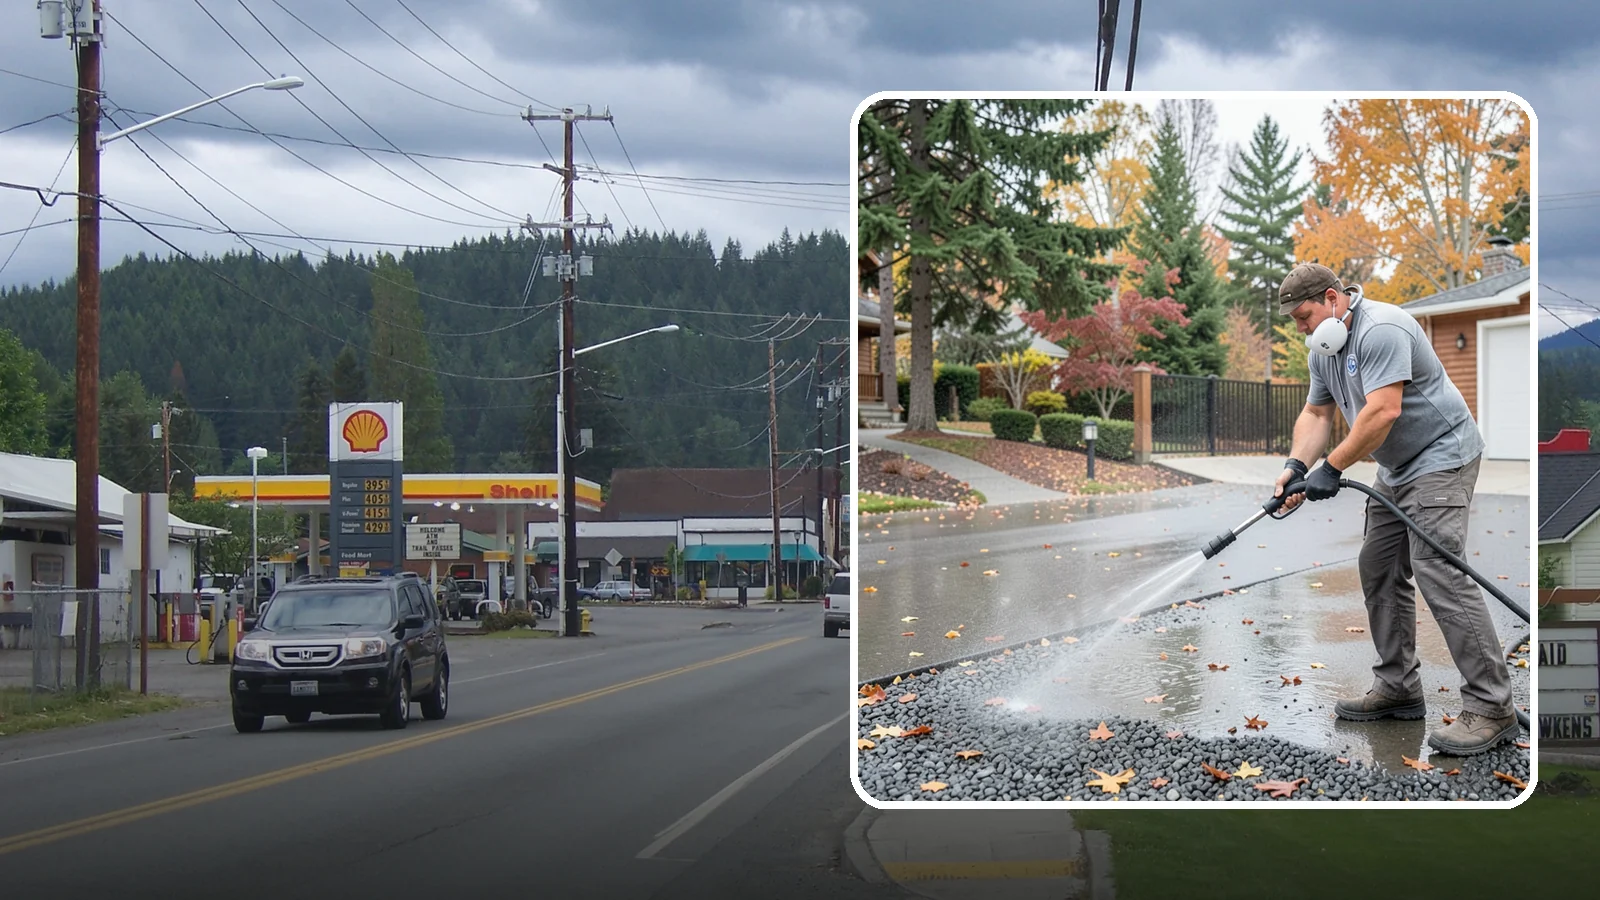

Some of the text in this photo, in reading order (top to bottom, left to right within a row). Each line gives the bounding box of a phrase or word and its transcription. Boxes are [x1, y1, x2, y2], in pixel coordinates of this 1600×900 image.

[366, 480, 383, 490] 395
[490, 485, 547, 498] Shell
[366, 494, 383, 504] 405
[366, 508, 383, 518] 415
[366, 522, 383, 532] 429
